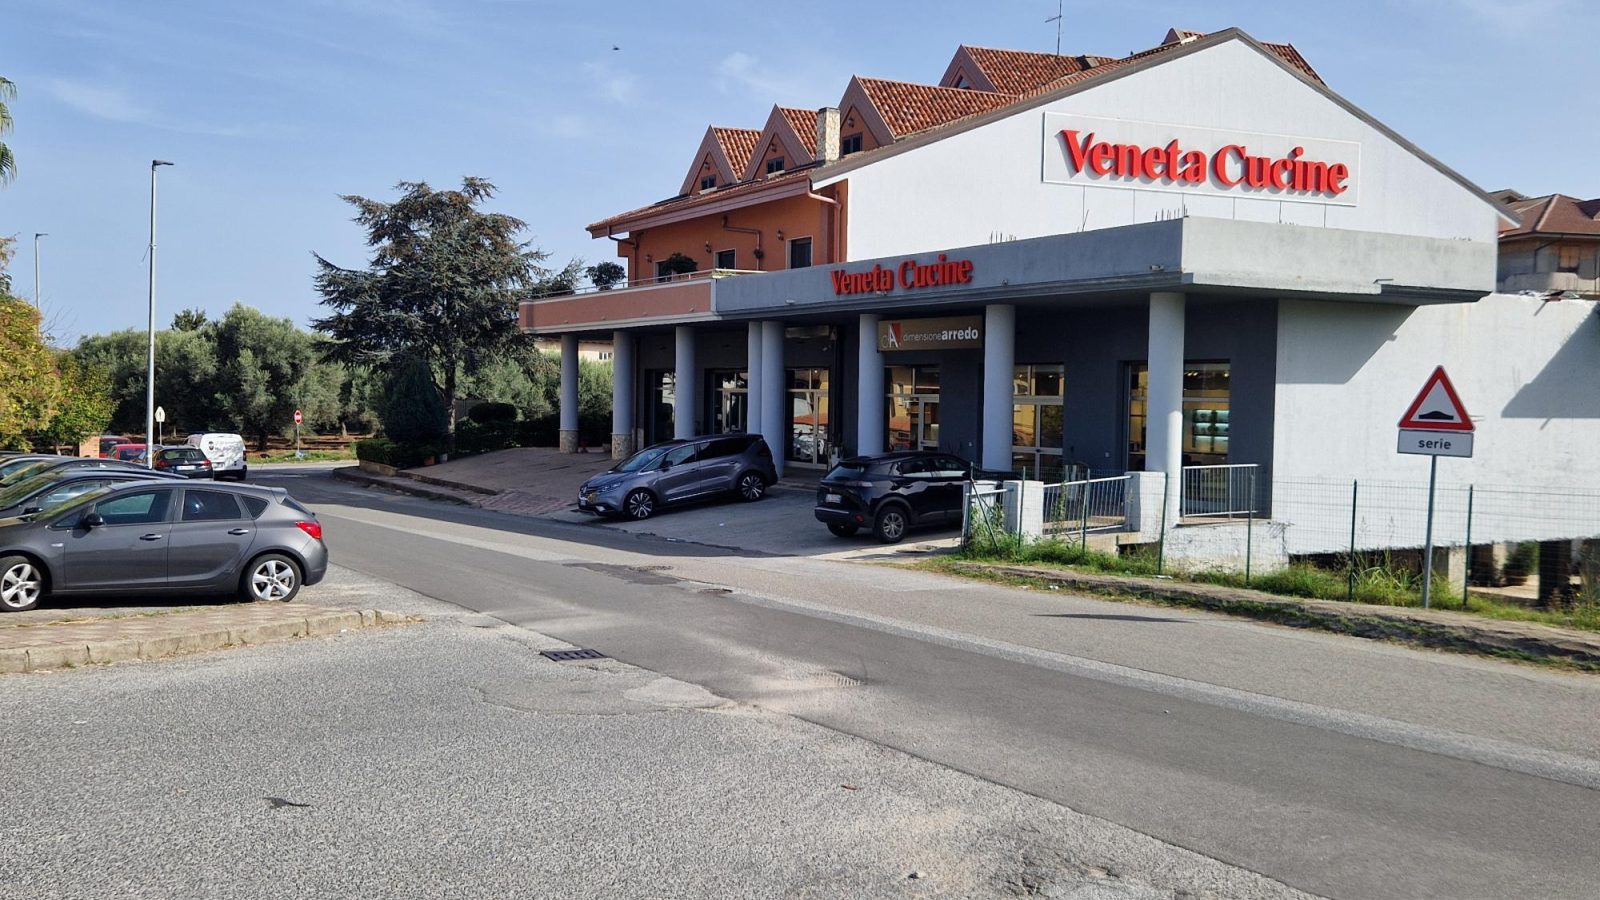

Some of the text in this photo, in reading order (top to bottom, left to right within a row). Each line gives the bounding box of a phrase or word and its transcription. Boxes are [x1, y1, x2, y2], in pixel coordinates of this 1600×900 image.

[1057, 129, 1349, 195] Veneta Cucine
[831, 254, 973, 295] Veneta Cucine
[1418, 438, 1451, 449] serie
